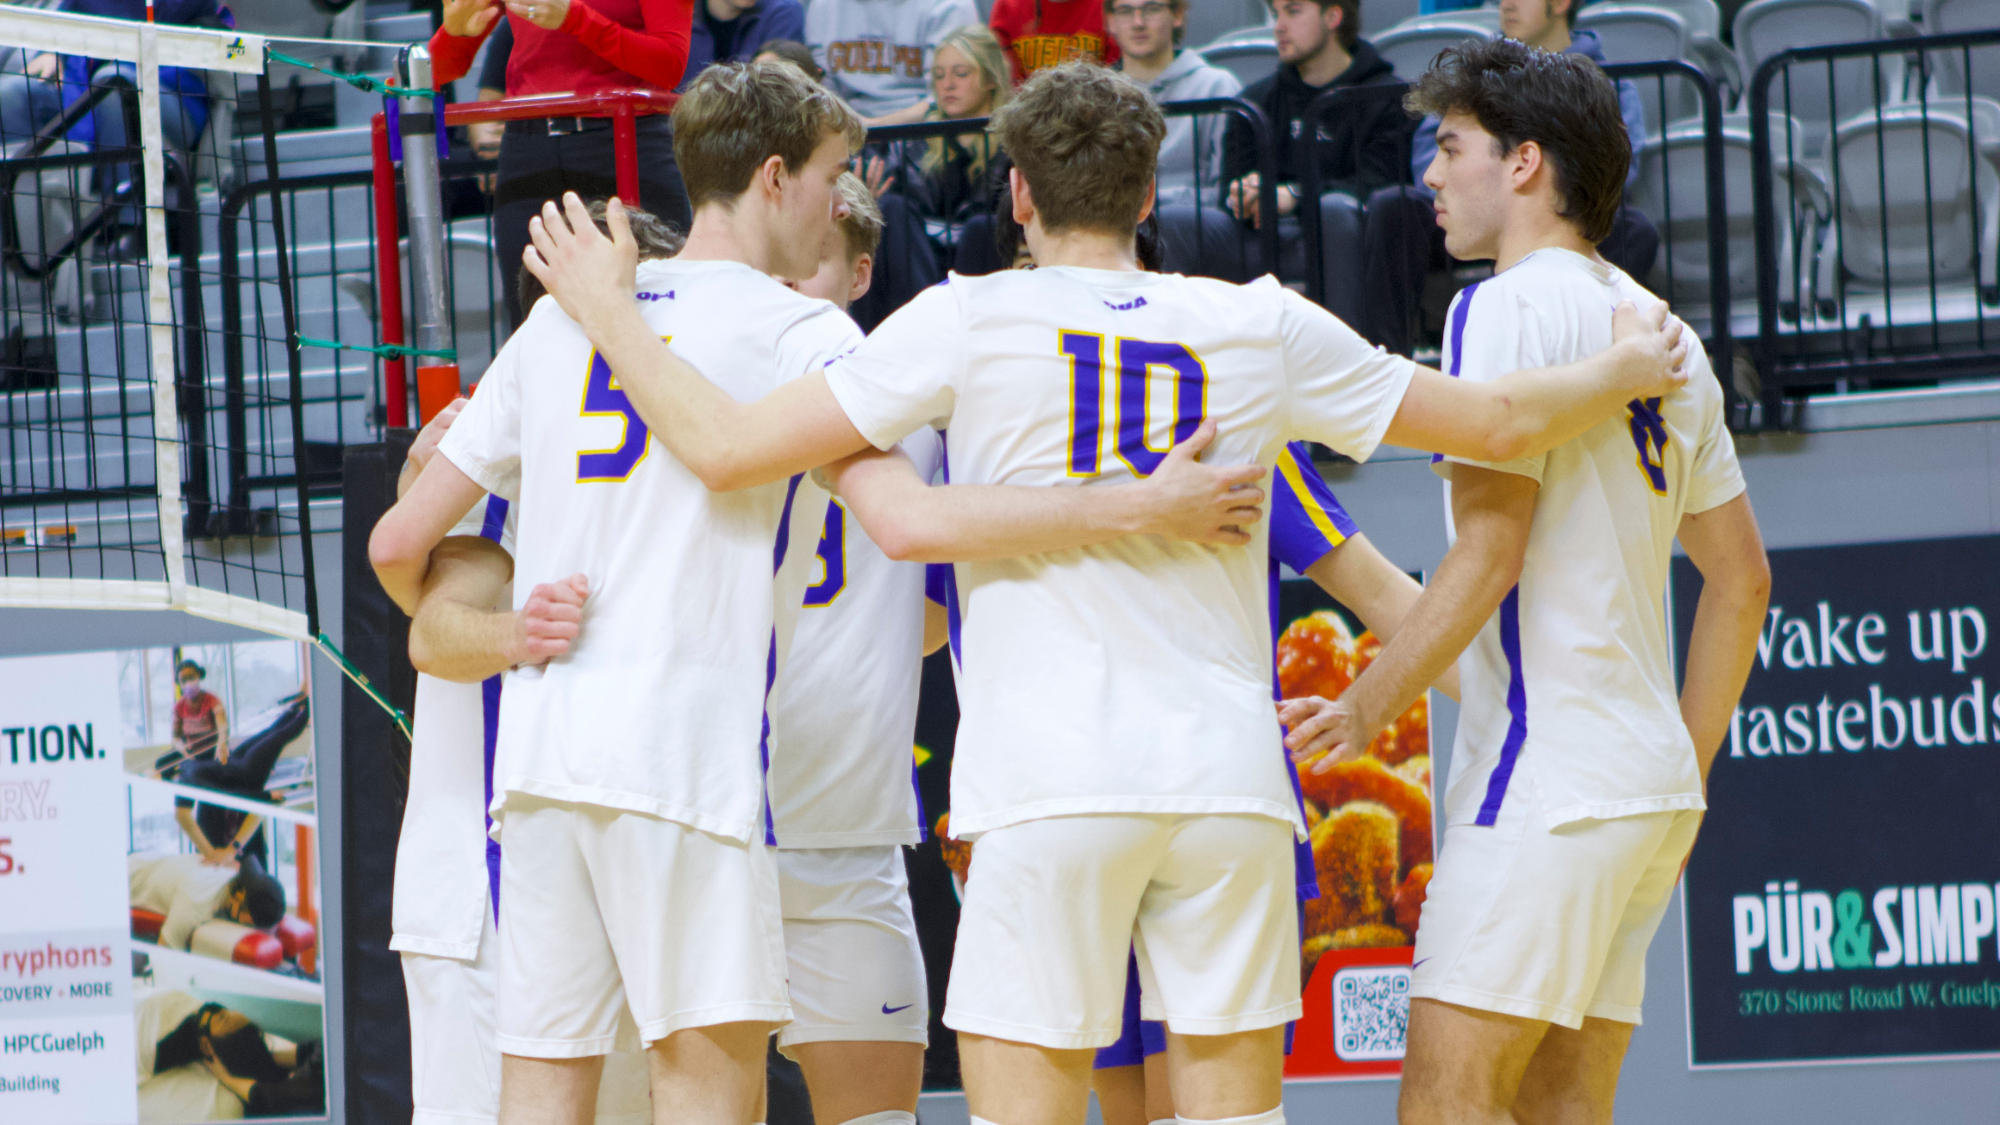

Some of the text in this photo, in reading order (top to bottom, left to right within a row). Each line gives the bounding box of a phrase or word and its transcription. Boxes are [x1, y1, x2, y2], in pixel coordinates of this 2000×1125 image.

[827, 40, 923, 77] GUELPH
[576, 335, 673, 484] 5
[1058, 328, 1209, 479] 10
[1908, 606, 1987, 673] up
[2, 723, 105, 764] TION.
[70, 981, 113, 998] MORE
[1739, 990, 1781, 1016] 370
[1785, 989, 1845, 1015] Stone
[1850, 983, 1904, 1012] Road
[4, 1031, 104, 1055] HPCGuelph
